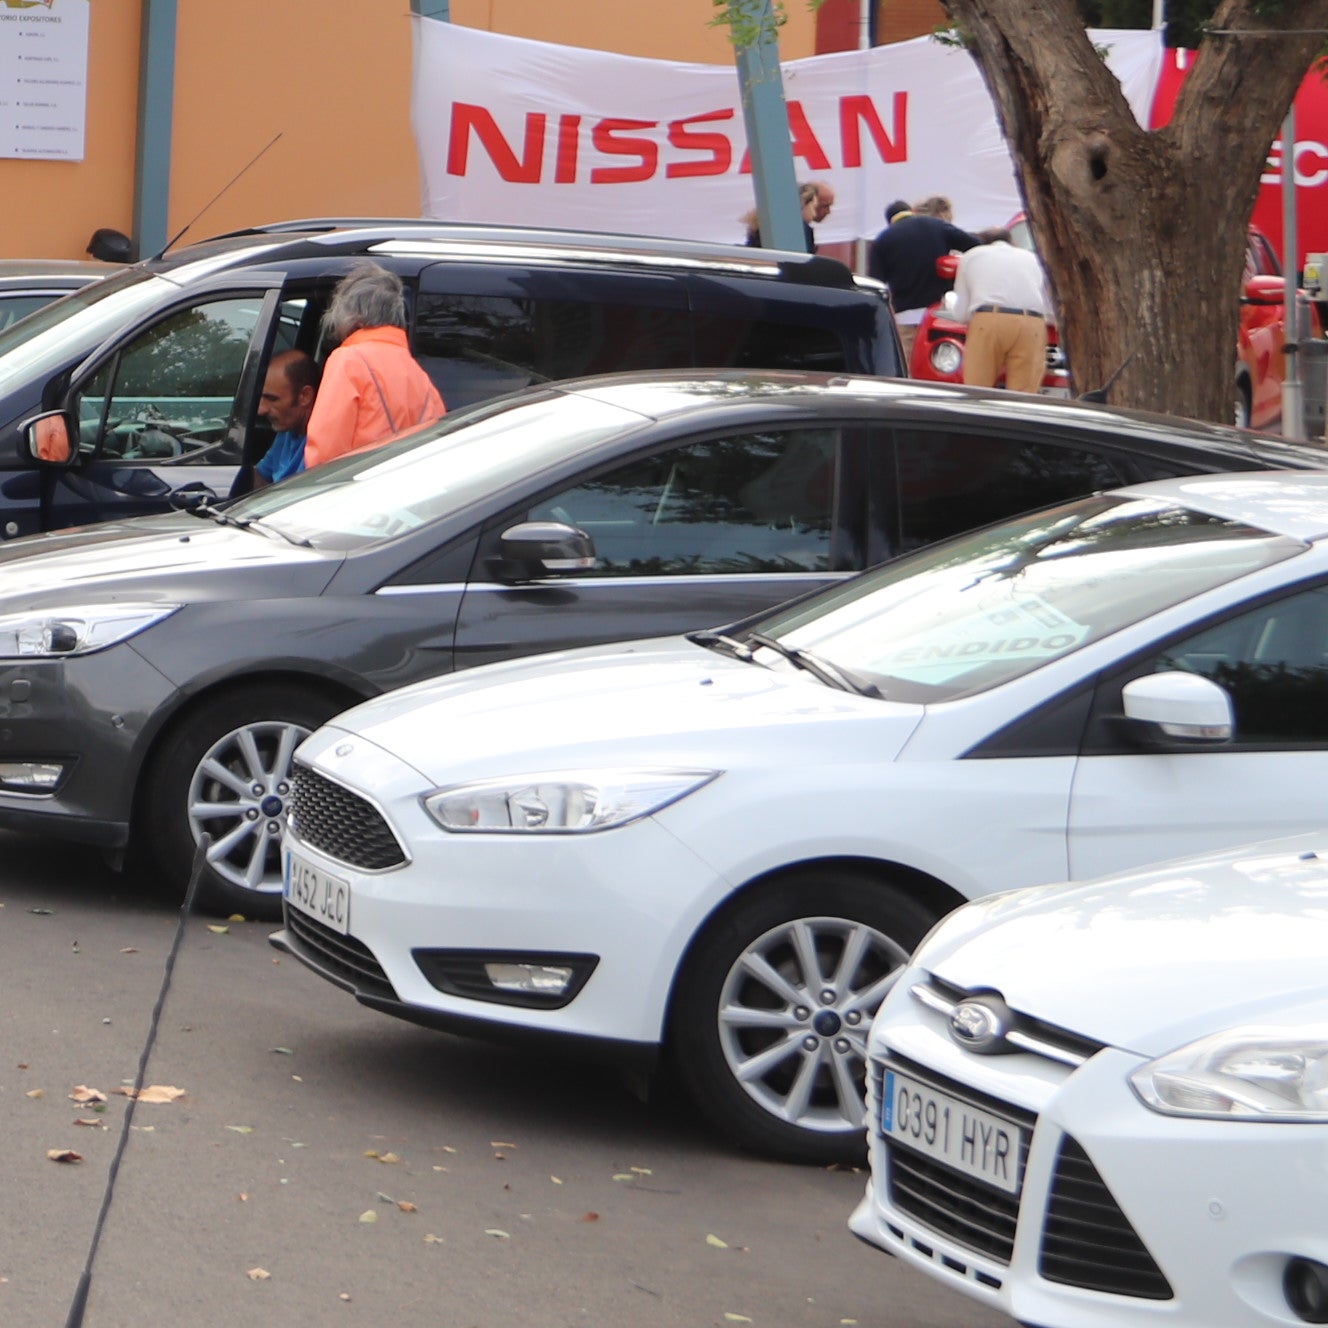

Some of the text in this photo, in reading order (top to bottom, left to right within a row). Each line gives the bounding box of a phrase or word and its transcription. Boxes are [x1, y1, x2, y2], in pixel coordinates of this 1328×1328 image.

[19, 15, 62, 23] EXPOSITORES
[868, 634, 1077, 667] ENDIDO
[897, 1086, 1009, 1181] 0391 HYR
